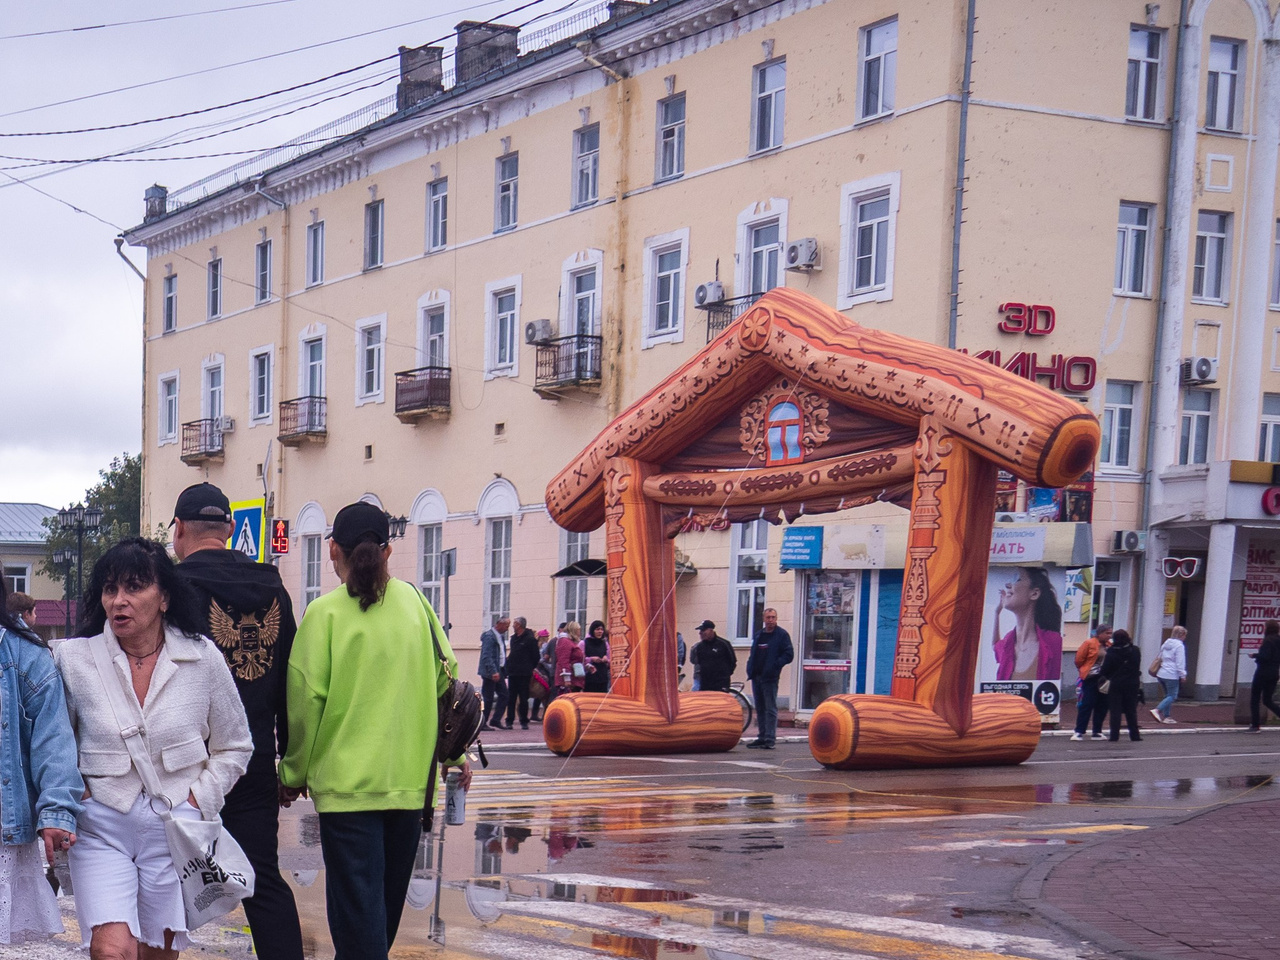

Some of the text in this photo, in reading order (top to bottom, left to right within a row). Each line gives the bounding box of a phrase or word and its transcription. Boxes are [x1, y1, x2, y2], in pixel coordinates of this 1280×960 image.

[998, 302, 1056, 335] 3D
[959, 348, 1097, 392] ИНО
[272, 537, 288, 552] 43
